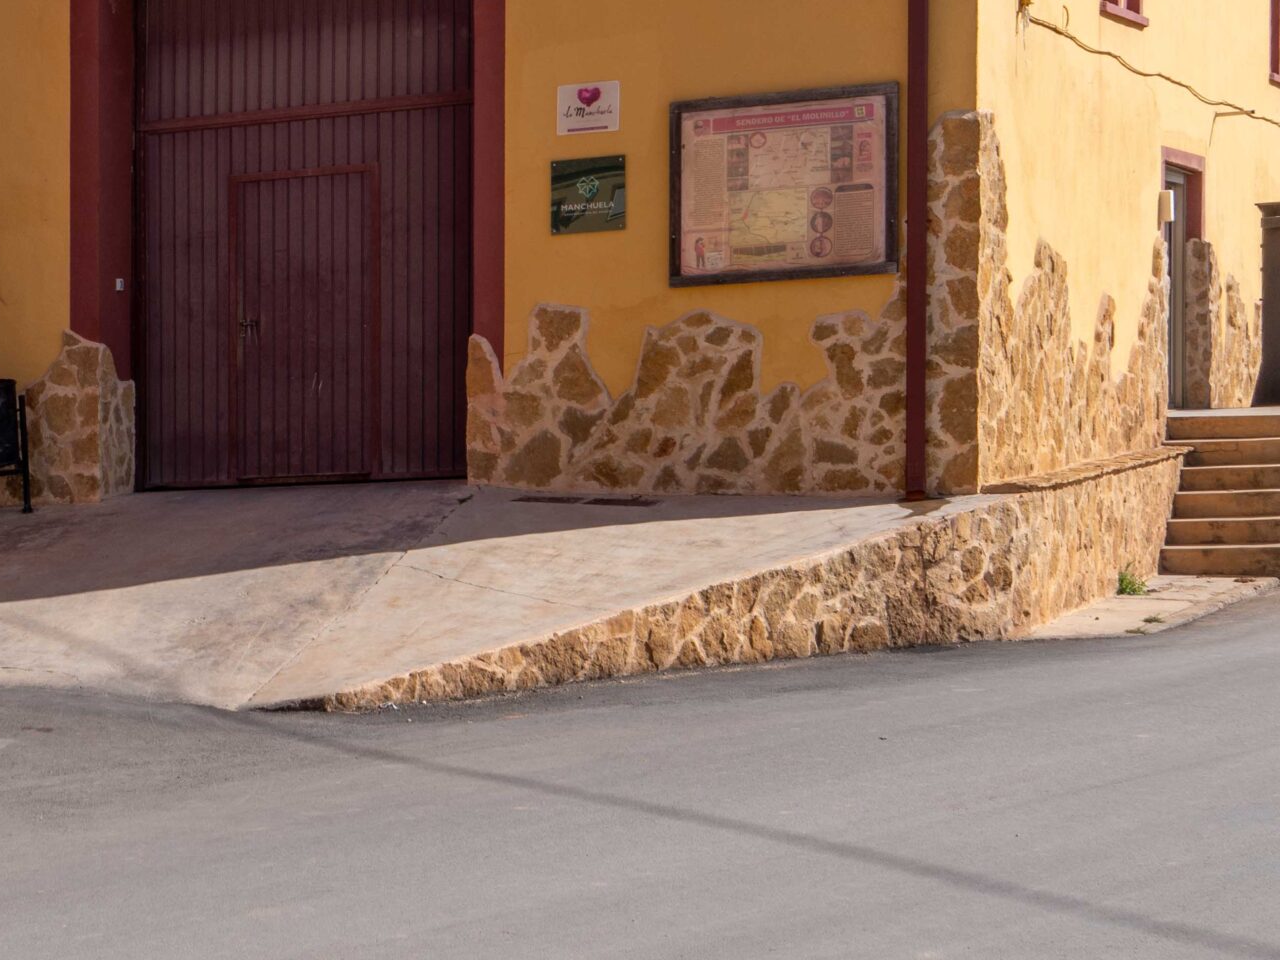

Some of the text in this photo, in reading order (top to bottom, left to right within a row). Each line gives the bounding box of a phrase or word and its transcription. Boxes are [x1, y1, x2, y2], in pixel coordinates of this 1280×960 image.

[735, 116, 773, 127] SENDERO
[774, 115, 785, 124] DE
[560, 200, 615, 212] MANCHUELA
